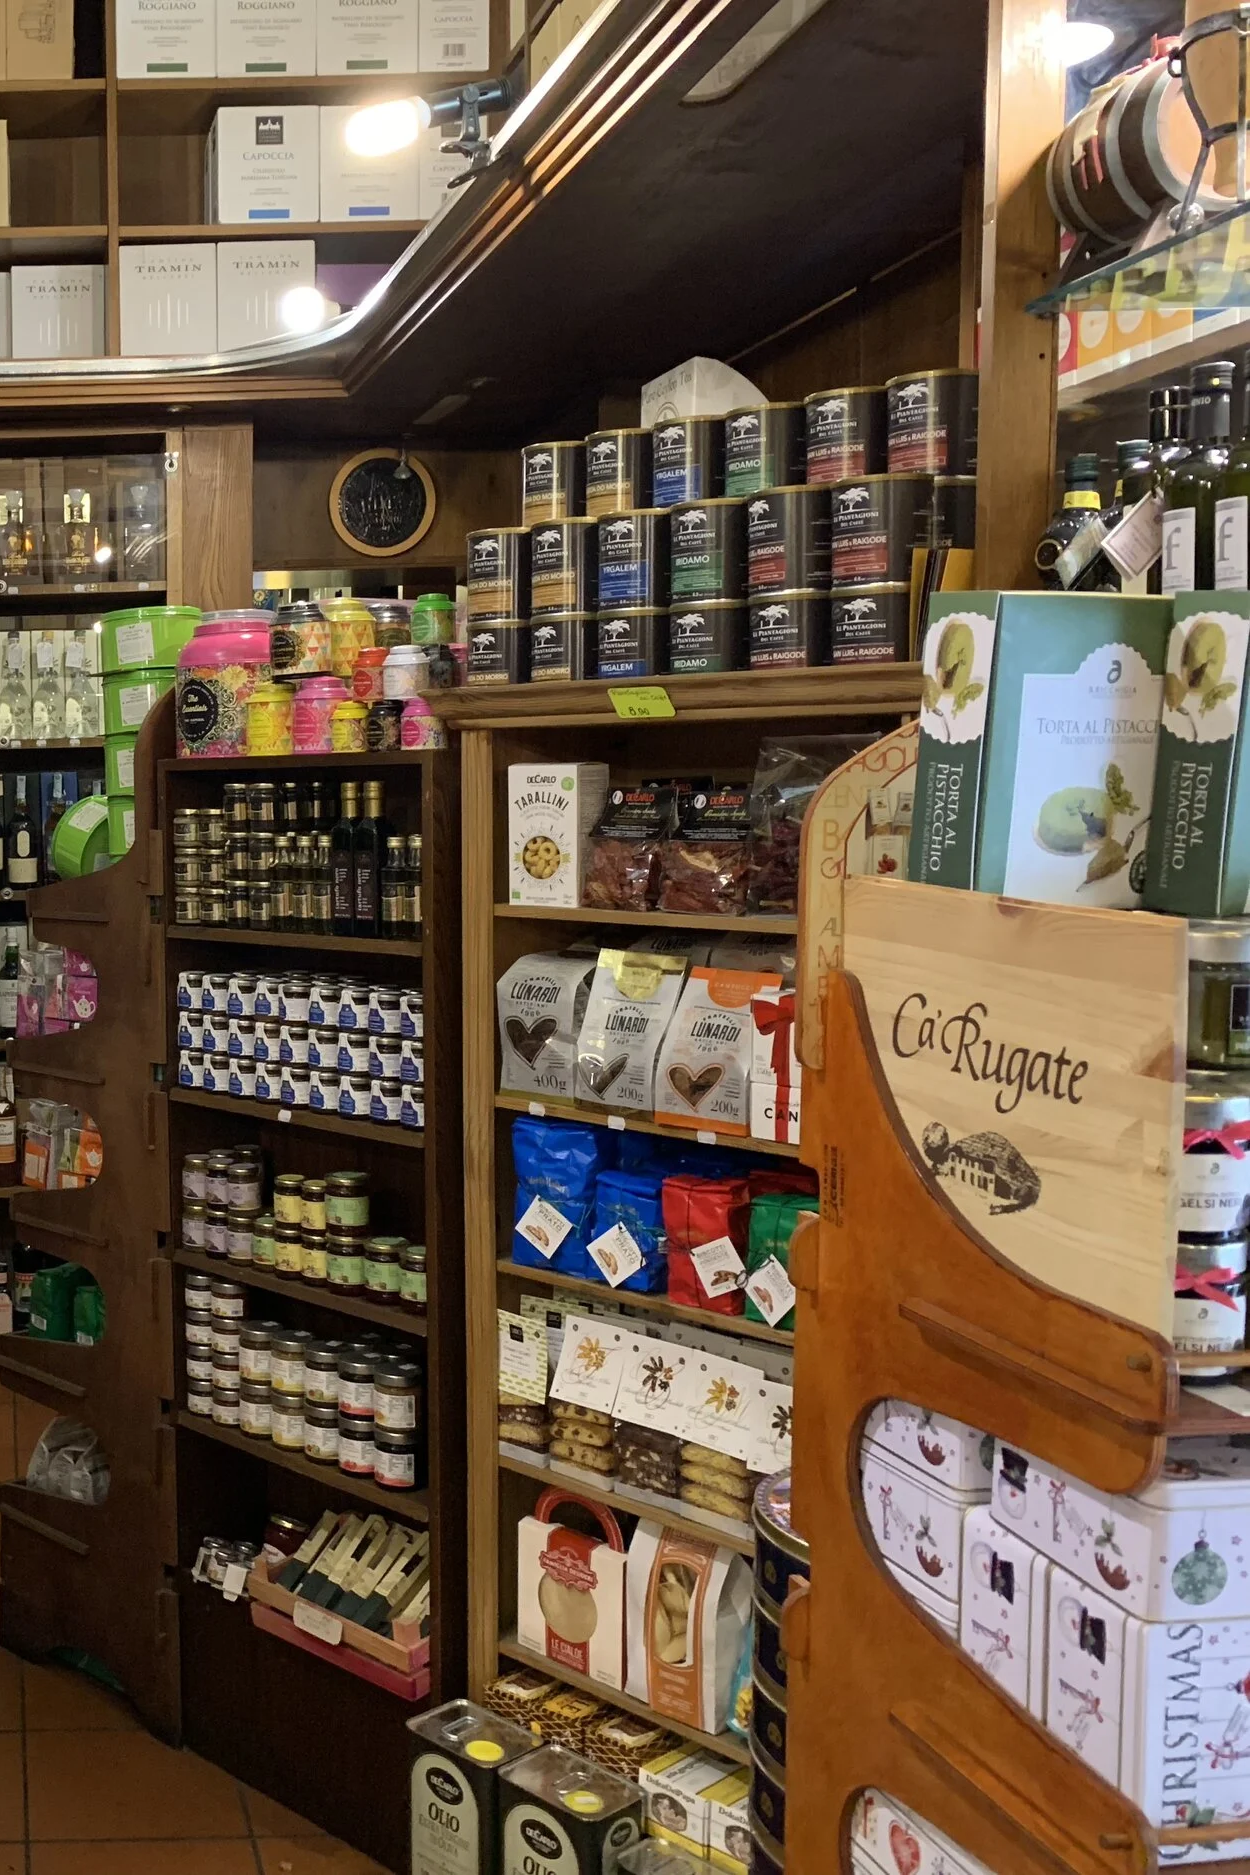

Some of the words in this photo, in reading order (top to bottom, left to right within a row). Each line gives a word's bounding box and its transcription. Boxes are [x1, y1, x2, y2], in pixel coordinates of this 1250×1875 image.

[243, 151, 294, 161] CAPOCCIA
[135, 264, 202, 273] TRAMIN
[233, 261, 300, 269] TRAMIN
[26, 285, 91, 293] TRAMIN
[912, 429, 947, 441] RAIGODE
[831, 444, 864, 455] RAIGODE
[854, 536, 887, 545] RAIGODE
[775, 651, 805, 660] RAIGODE
[859, 647, 894, 656] RAIGODE
[1037, 717, 1081, 735] TORTA
[1084, 718, 1101, 734] AL
[947, 763, 964, 818] TORTA
[1195, 762, 1213, 818] TORTA
[514, 791, 569, 811] TARALLINI
[929, 763, 950, 872] PISTACCHIO
[1172, 762, 1196, 870] PISTACCHIO
[945, 821, 956, 849] AL
[1190, 821, 1204, 848] AL
[510, 982, 561, 1003] LUNARDI
[605, 1014, 649, 1033] LUNARDI
[690, 1024, 741, 1043] LUNARDI
[941, 1002, 1089, 1114] Rugate
[533, 1074, 567, 1091] 400g
[617, 1086, 644, 1102] 200g
[710, 1098, 740, 1116] 200g
[1158, 1622, 1204, 1861] CHRISTMAS
[428, 1801, 461, 1833] OLIO
